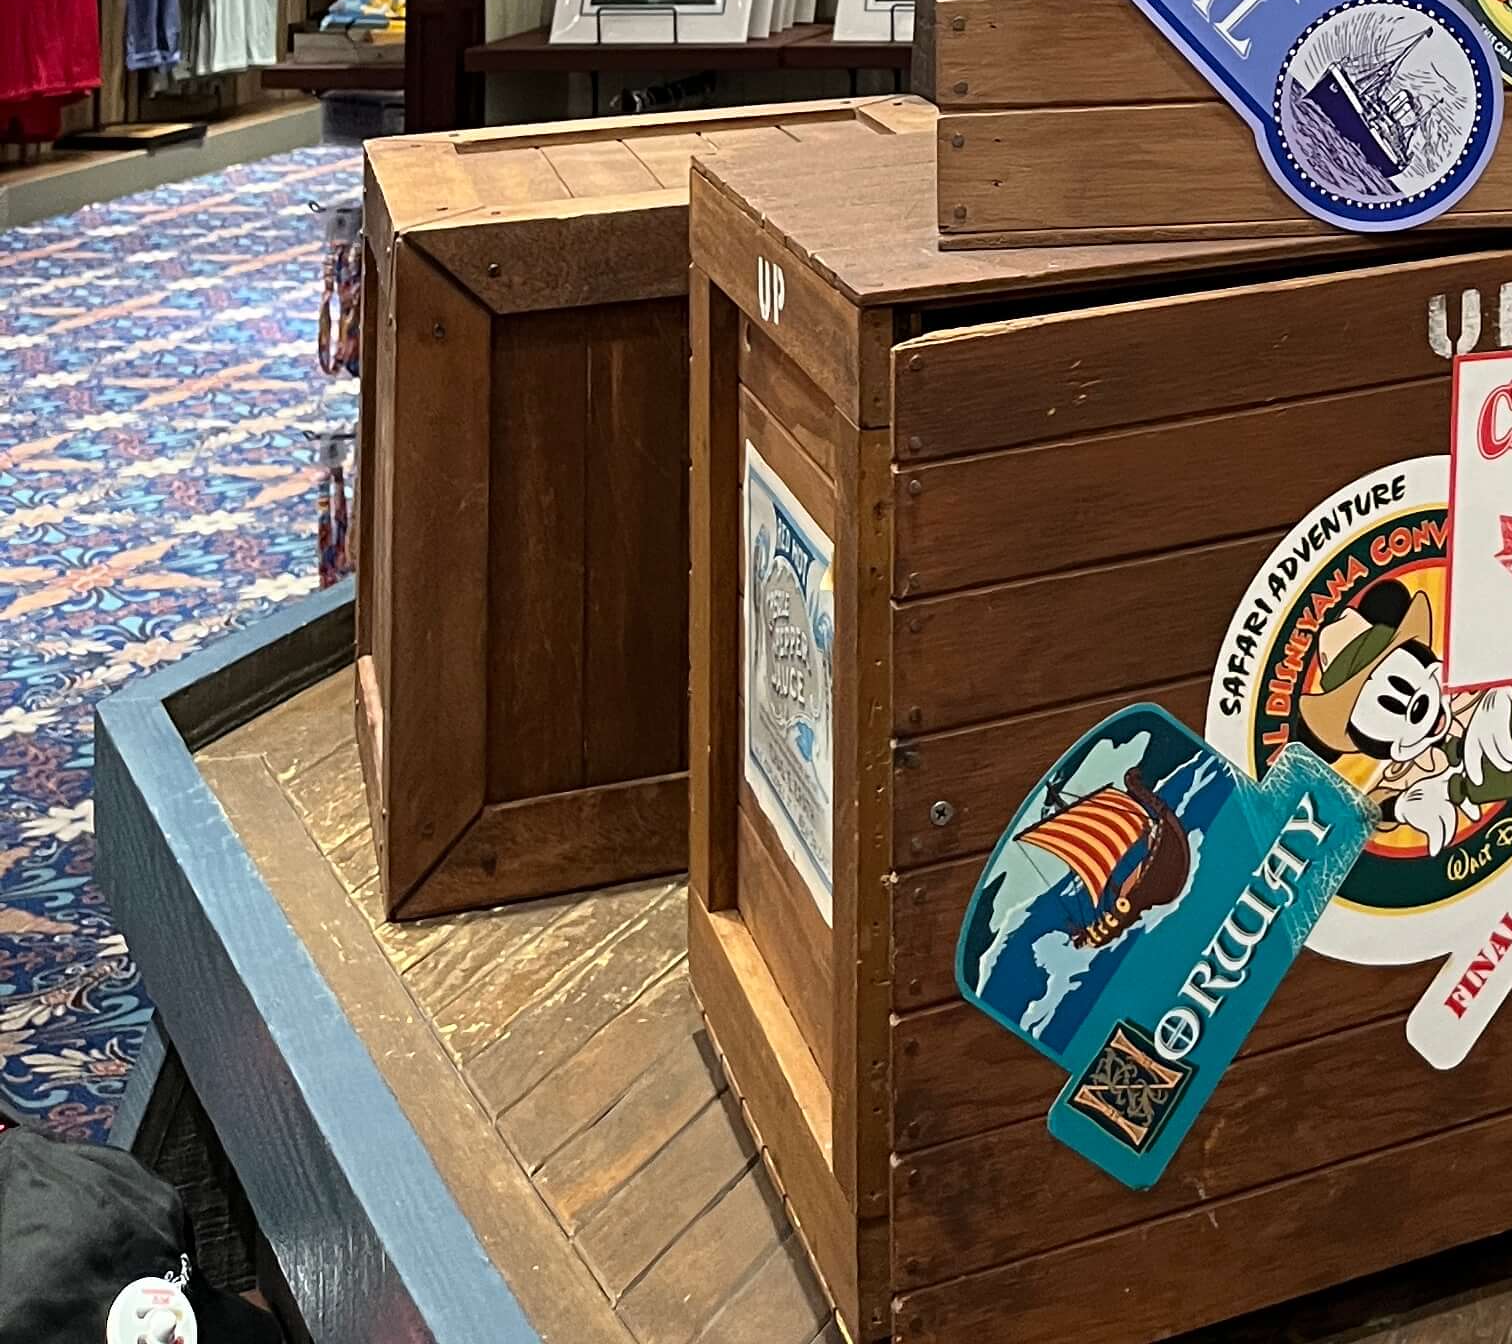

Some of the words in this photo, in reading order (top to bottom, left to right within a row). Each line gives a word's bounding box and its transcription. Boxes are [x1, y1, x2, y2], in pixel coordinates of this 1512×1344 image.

[758, 255, 785, 326] UP
[1219, 597, 1274, 717] SAFARI
[1267, 474, 1406, 602] ADVENTURE
[1266, 555, 1369, 716] DISNEYANA
[1066, 790, 1335, 1149] NORWAY
